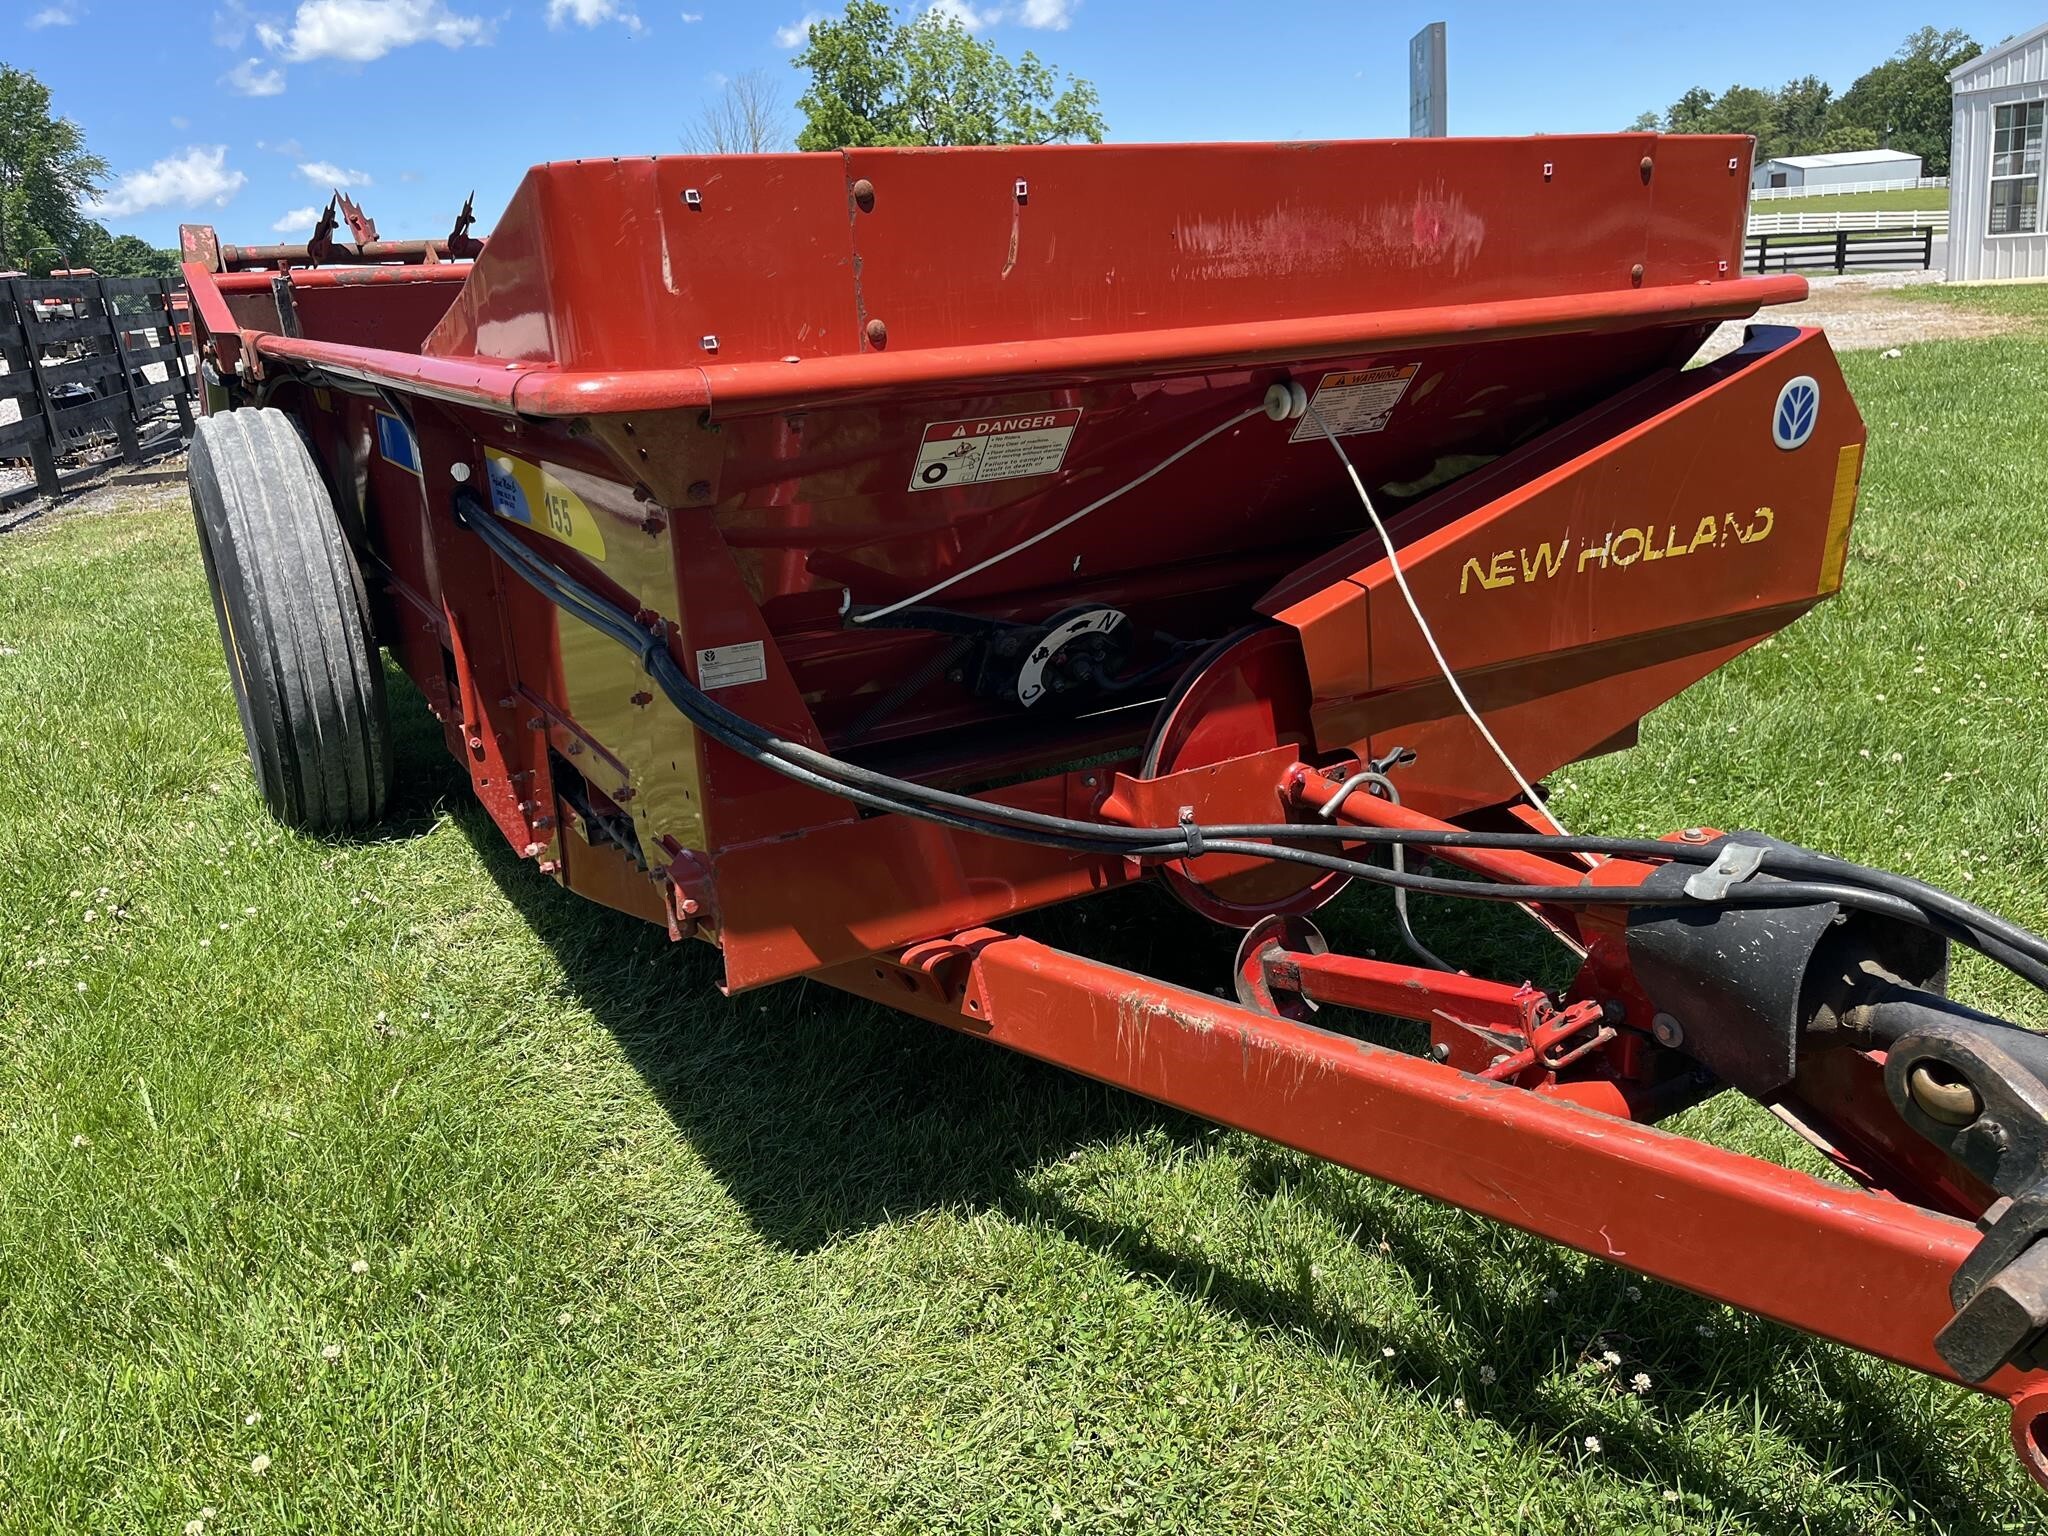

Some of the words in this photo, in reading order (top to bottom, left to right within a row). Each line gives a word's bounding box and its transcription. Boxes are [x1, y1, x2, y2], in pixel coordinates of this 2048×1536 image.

[1351, 369, 1400, 384] WARNING
[975, 416, 1056, 434] DANGER
[544, 492, 573, 538] 155
[1459, 538, 1570, 594] NEW
[1577, 506, 1775, 574] HOLLAND
[1096, 611, 1119, 631] N
[1021, 684, 1041, 700] C
